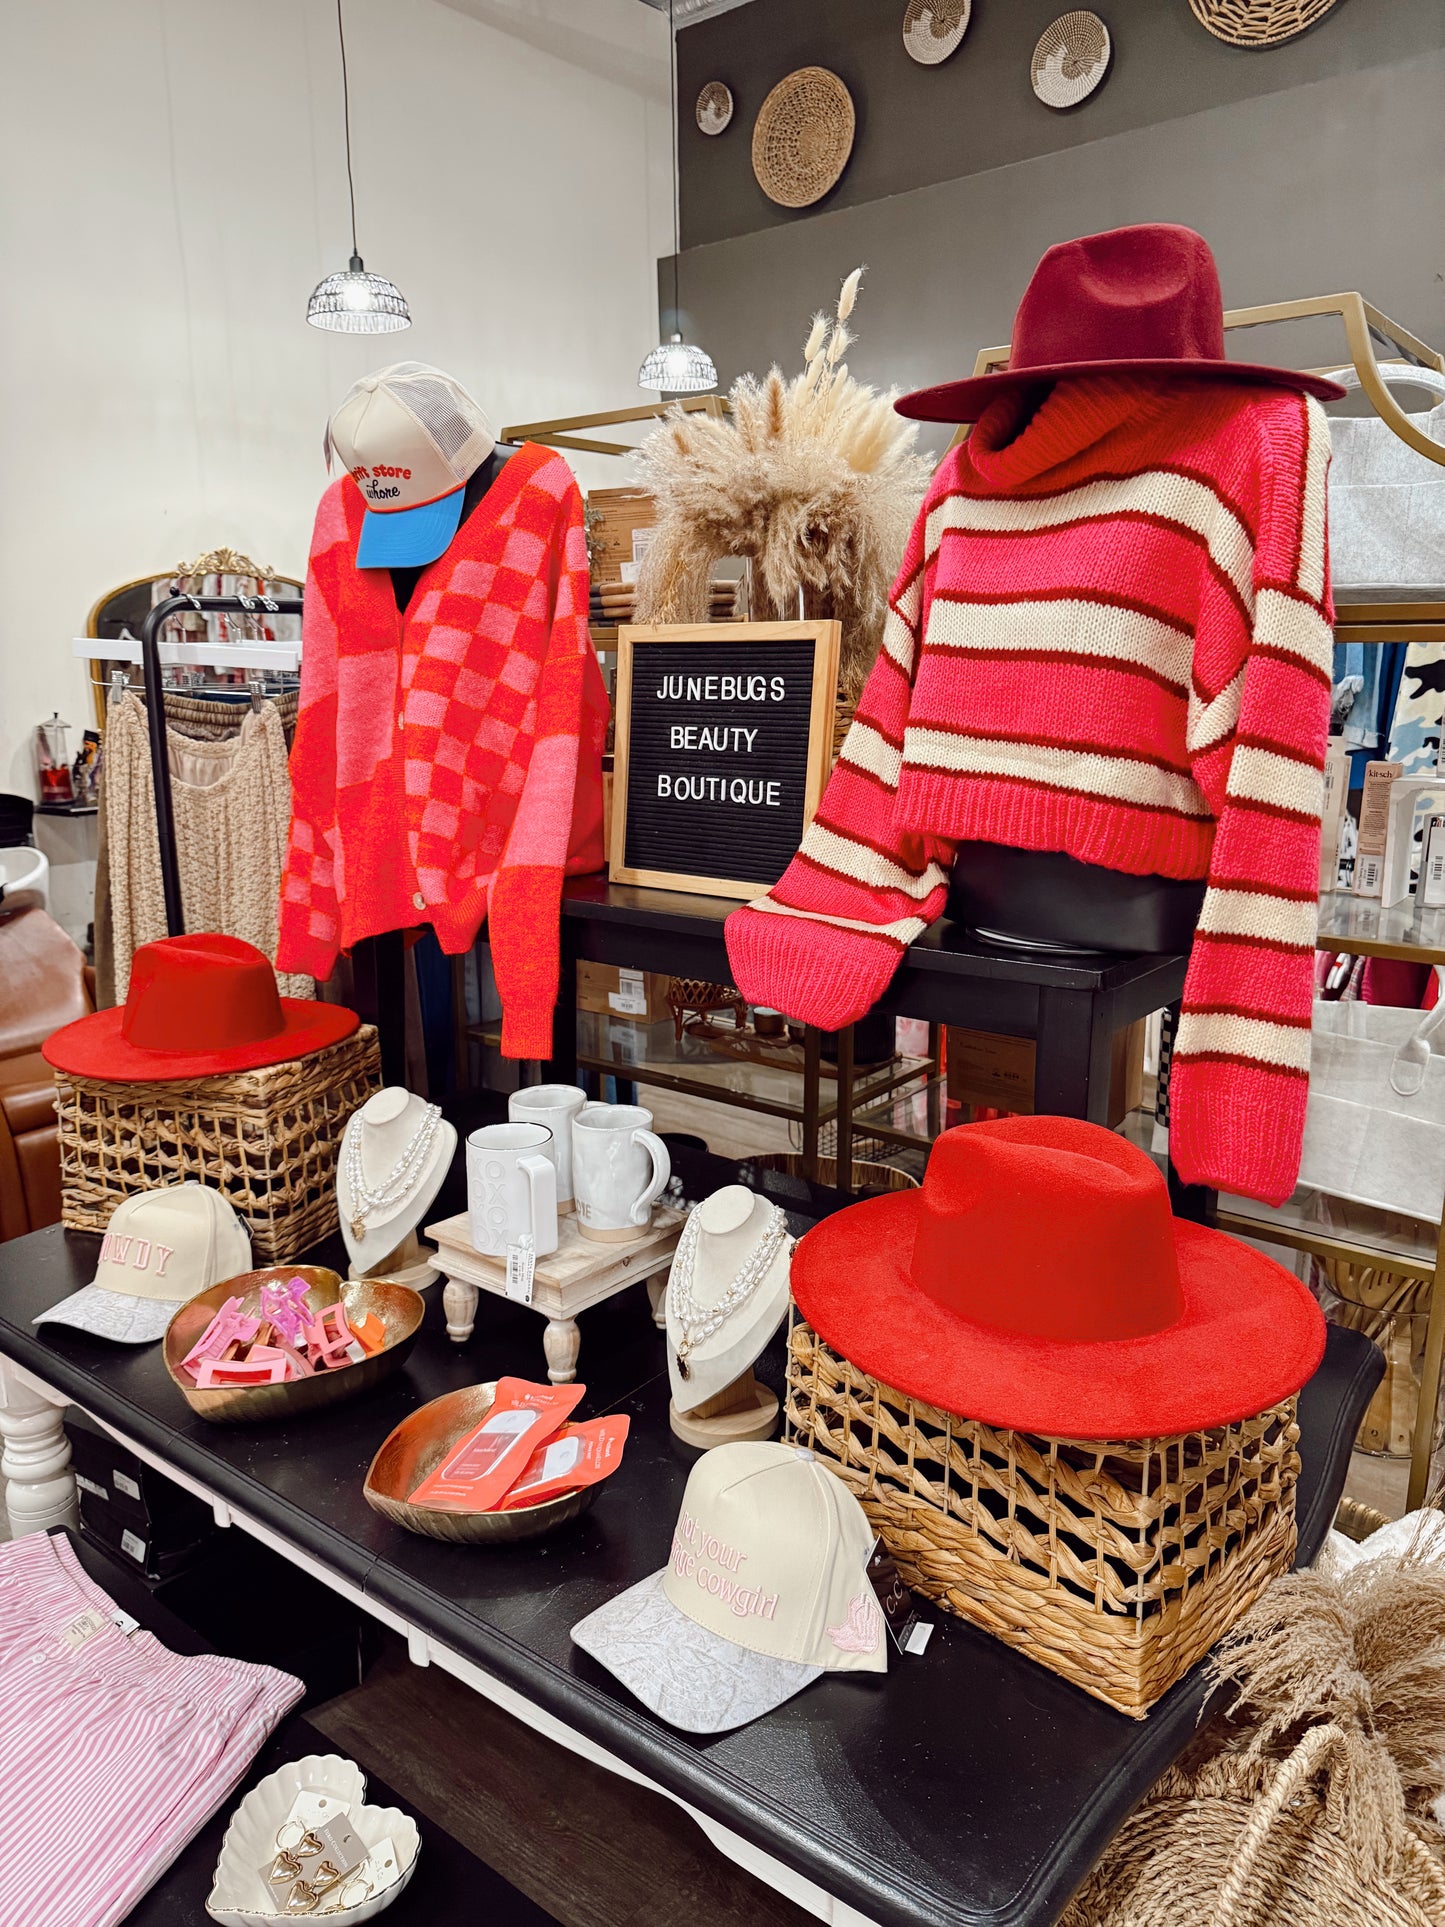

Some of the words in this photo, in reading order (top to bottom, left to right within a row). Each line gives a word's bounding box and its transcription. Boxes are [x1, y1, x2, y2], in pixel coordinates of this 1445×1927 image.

[371, 464, 412, 480] store
[366, 479, 401, 499] whore
[656, 675, 785, 701] JUNEBUGS
[670, 726, 758, 752] BEAUTY
[657, 774, 781, 806] BOUTIQUE
[98, 1232, 174, 1277] OWDY
[695, 1531, 748, 1574] your
[697, 1566, 780, 1621] cowgirl
